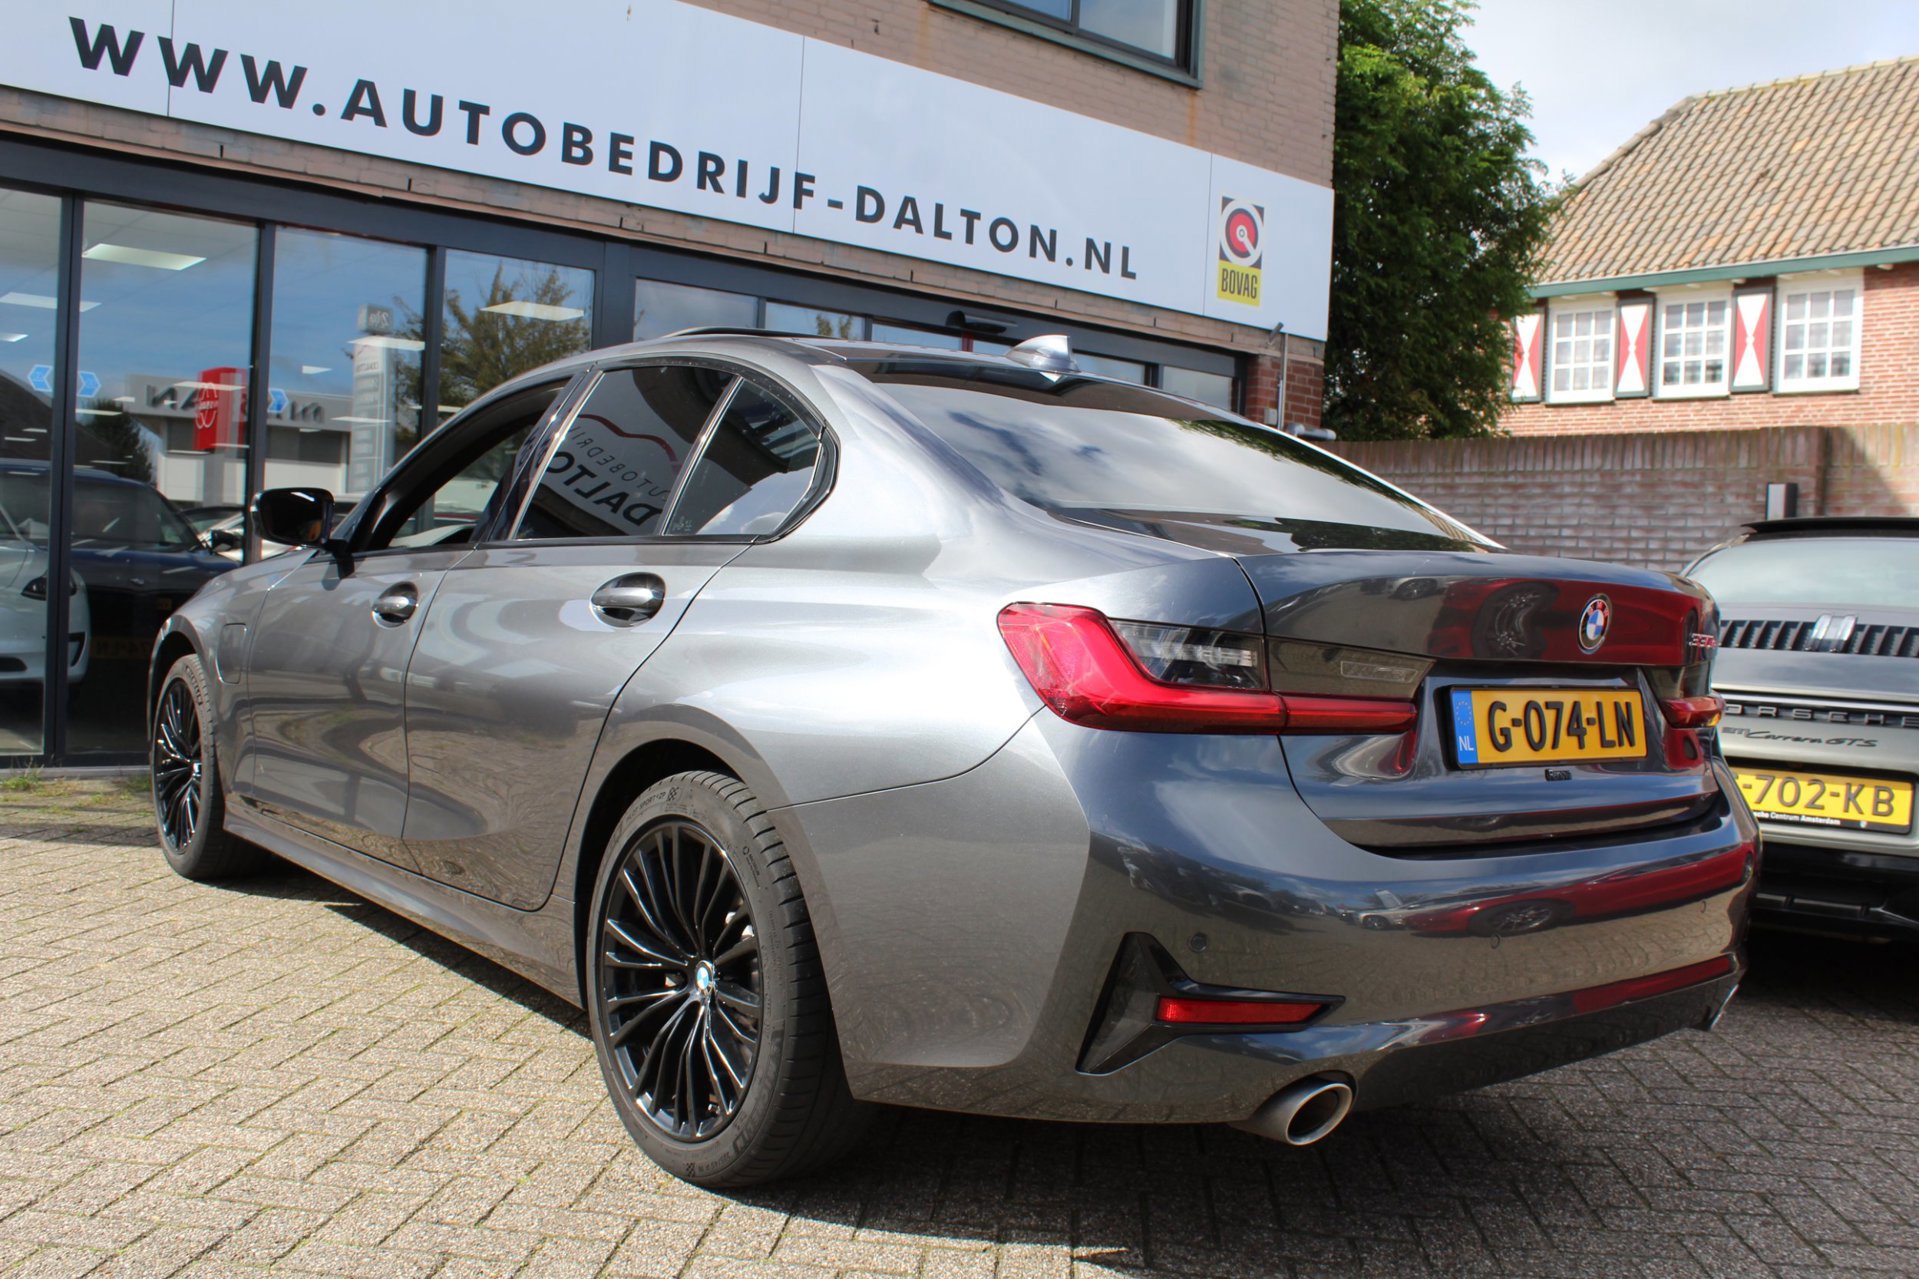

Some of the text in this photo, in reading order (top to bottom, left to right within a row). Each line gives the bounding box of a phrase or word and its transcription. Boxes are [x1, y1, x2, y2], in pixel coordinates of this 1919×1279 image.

[68, 16, 1137, 281] WWW.AUTOBEDRIJF-DALTON.NL
[1221, 268, 1258, 299] BOVAG
[1488, 700, 1636, 752] G-074-LN
[1724, 703, 1919, 728] ORSCHE
[1459, 736, 1474, 751] NL
[1825, 738, 1879, 747] GTS
[1735, 774, 1895, 817] -702-KB
